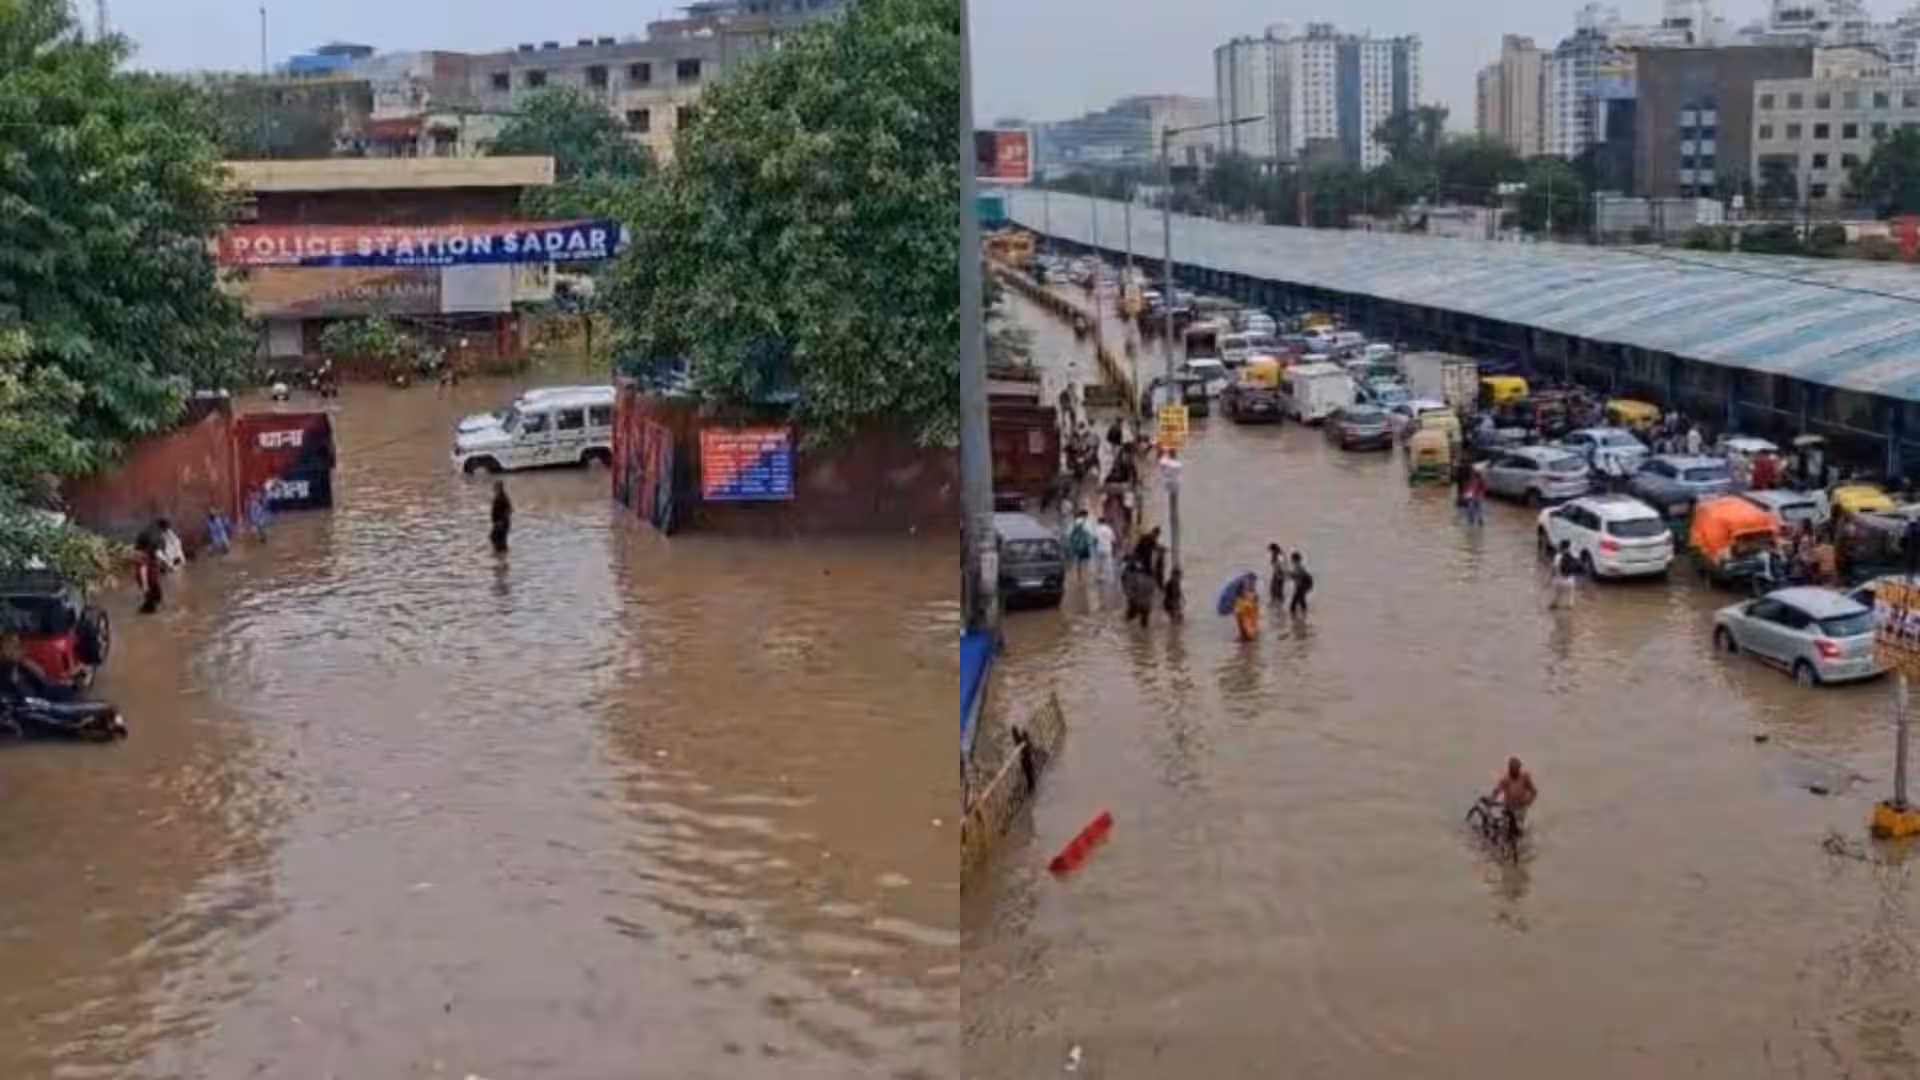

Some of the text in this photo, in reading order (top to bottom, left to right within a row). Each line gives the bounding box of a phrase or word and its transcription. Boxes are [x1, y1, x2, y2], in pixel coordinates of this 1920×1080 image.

[232, 229, 606, 256] POLICE STATION SADAR
[258, 429, 304, 448] थाना
